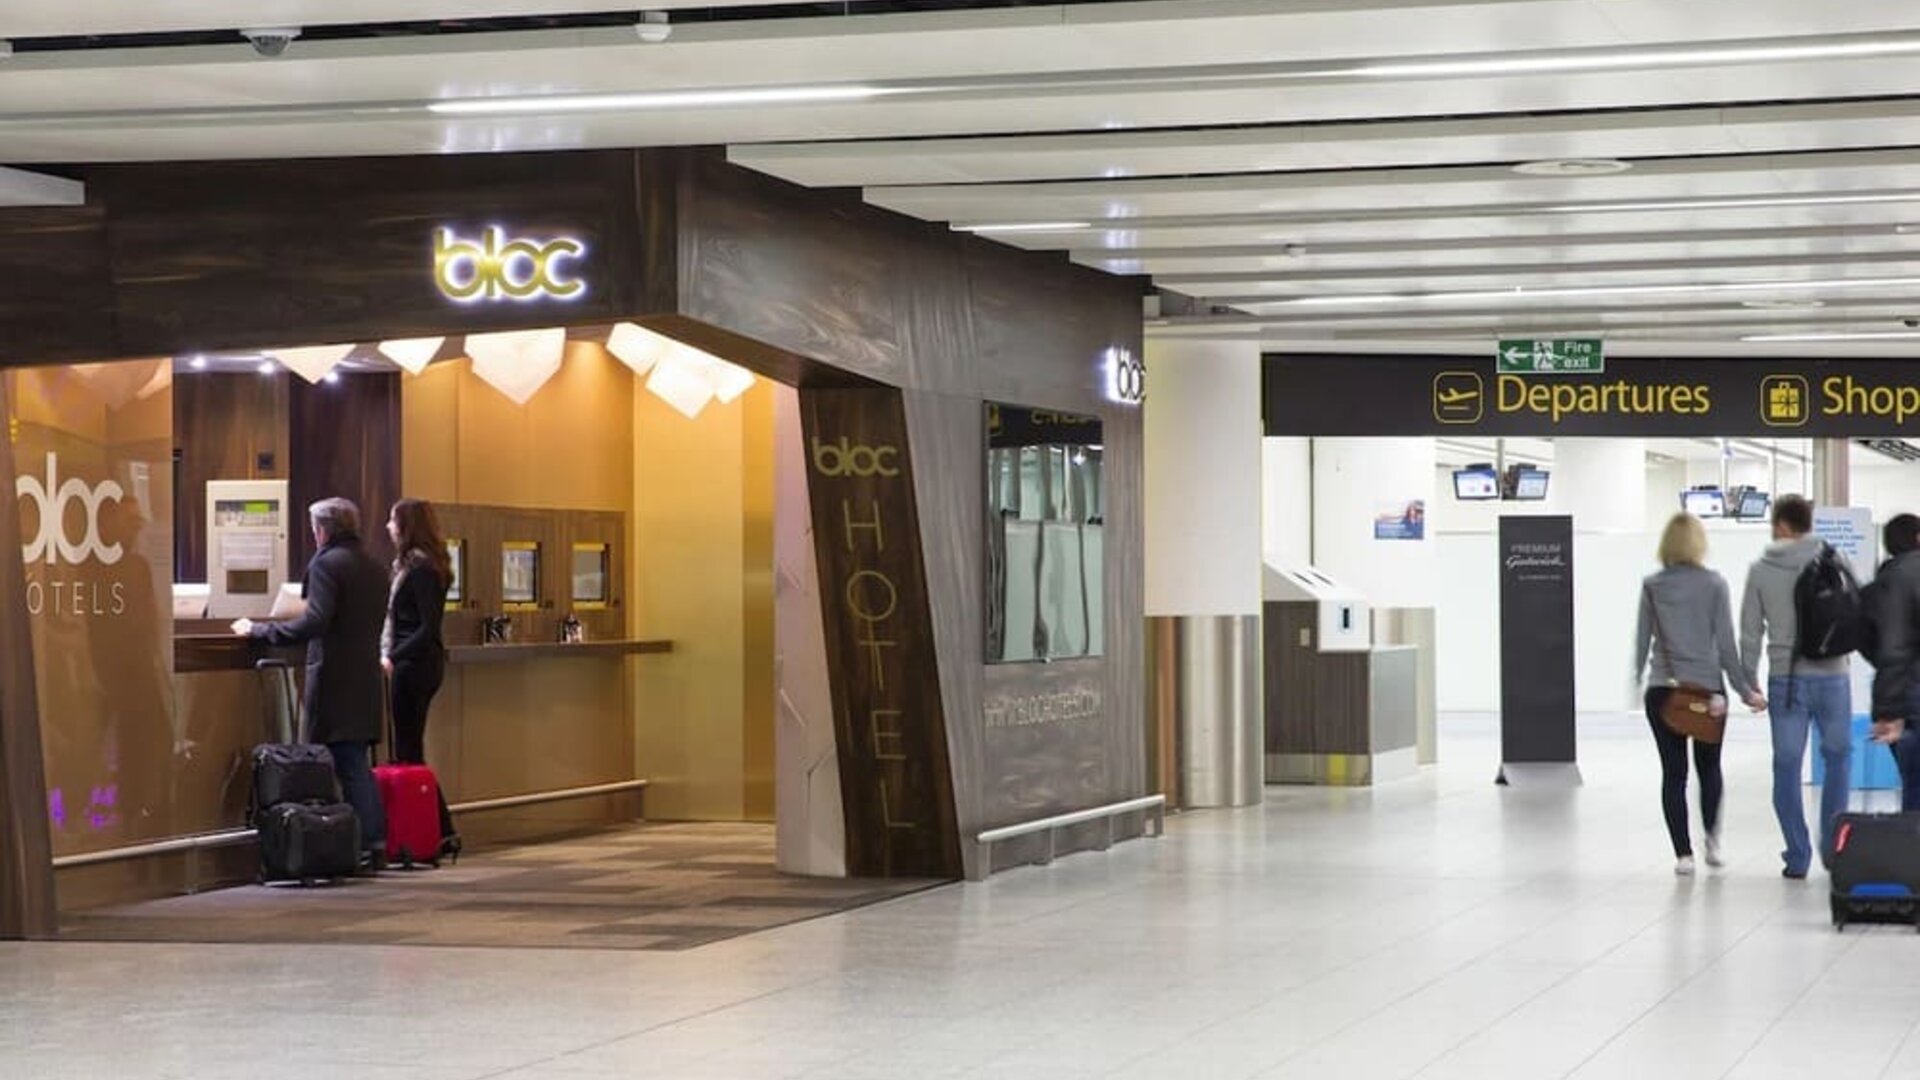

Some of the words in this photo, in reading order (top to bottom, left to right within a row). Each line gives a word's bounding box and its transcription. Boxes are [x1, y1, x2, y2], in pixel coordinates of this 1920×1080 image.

[434, 226, 583, 299] bloc
[1563, 357, 1590, 368] exit
[1564, 341, 1592, 353] Fire
[1498, 375, 1710, 422] Departures
[1823, 376, 1920, 424] Shop
[812, 436, 899, 477] bloc
[26, 581, 125, 615] OTELS
[843, 499, 916, 829] HOTEL
